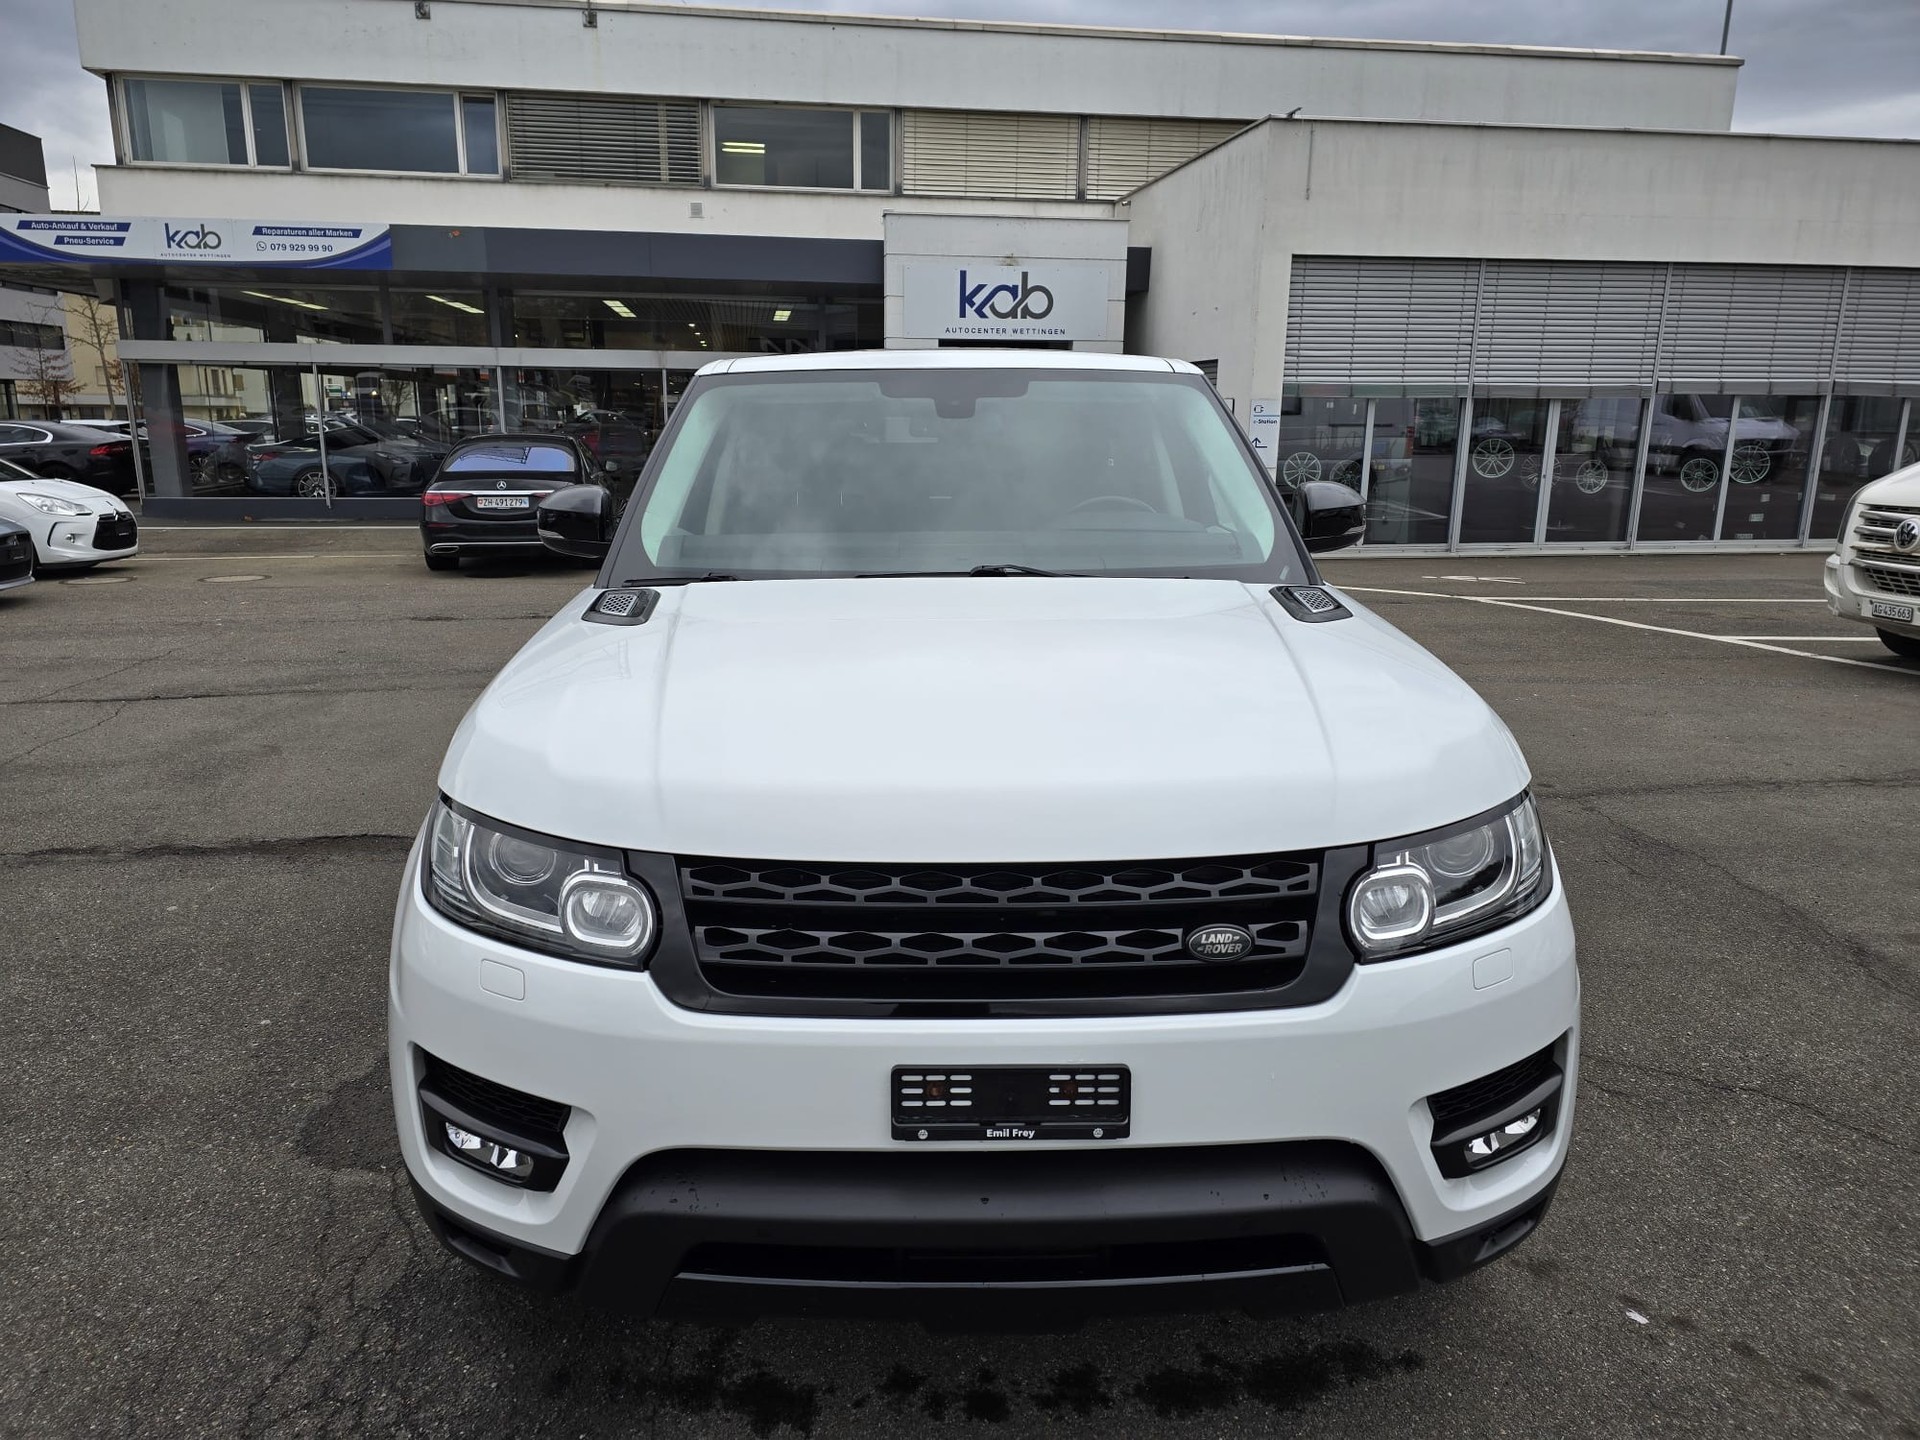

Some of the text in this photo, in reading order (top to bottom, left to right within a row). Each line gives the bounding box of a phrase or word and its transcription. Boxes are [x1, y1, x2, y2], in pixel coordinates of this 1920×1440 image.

[31, 222, 118, 231] Auto-Ankauf & Verkauf
[262, 227, 307, 236] Reparaturen
[64, 237, 115, 245] Pneu-Service
[270, 243, 333, 252] 079 929 99 90
[959, 270, 1054, 320] kab
[1201, 933, 1233, 944] LAND
[1203, 943, 1243, 954] ROVER
[986, 1128, 1036, 1139] Emil Frey
